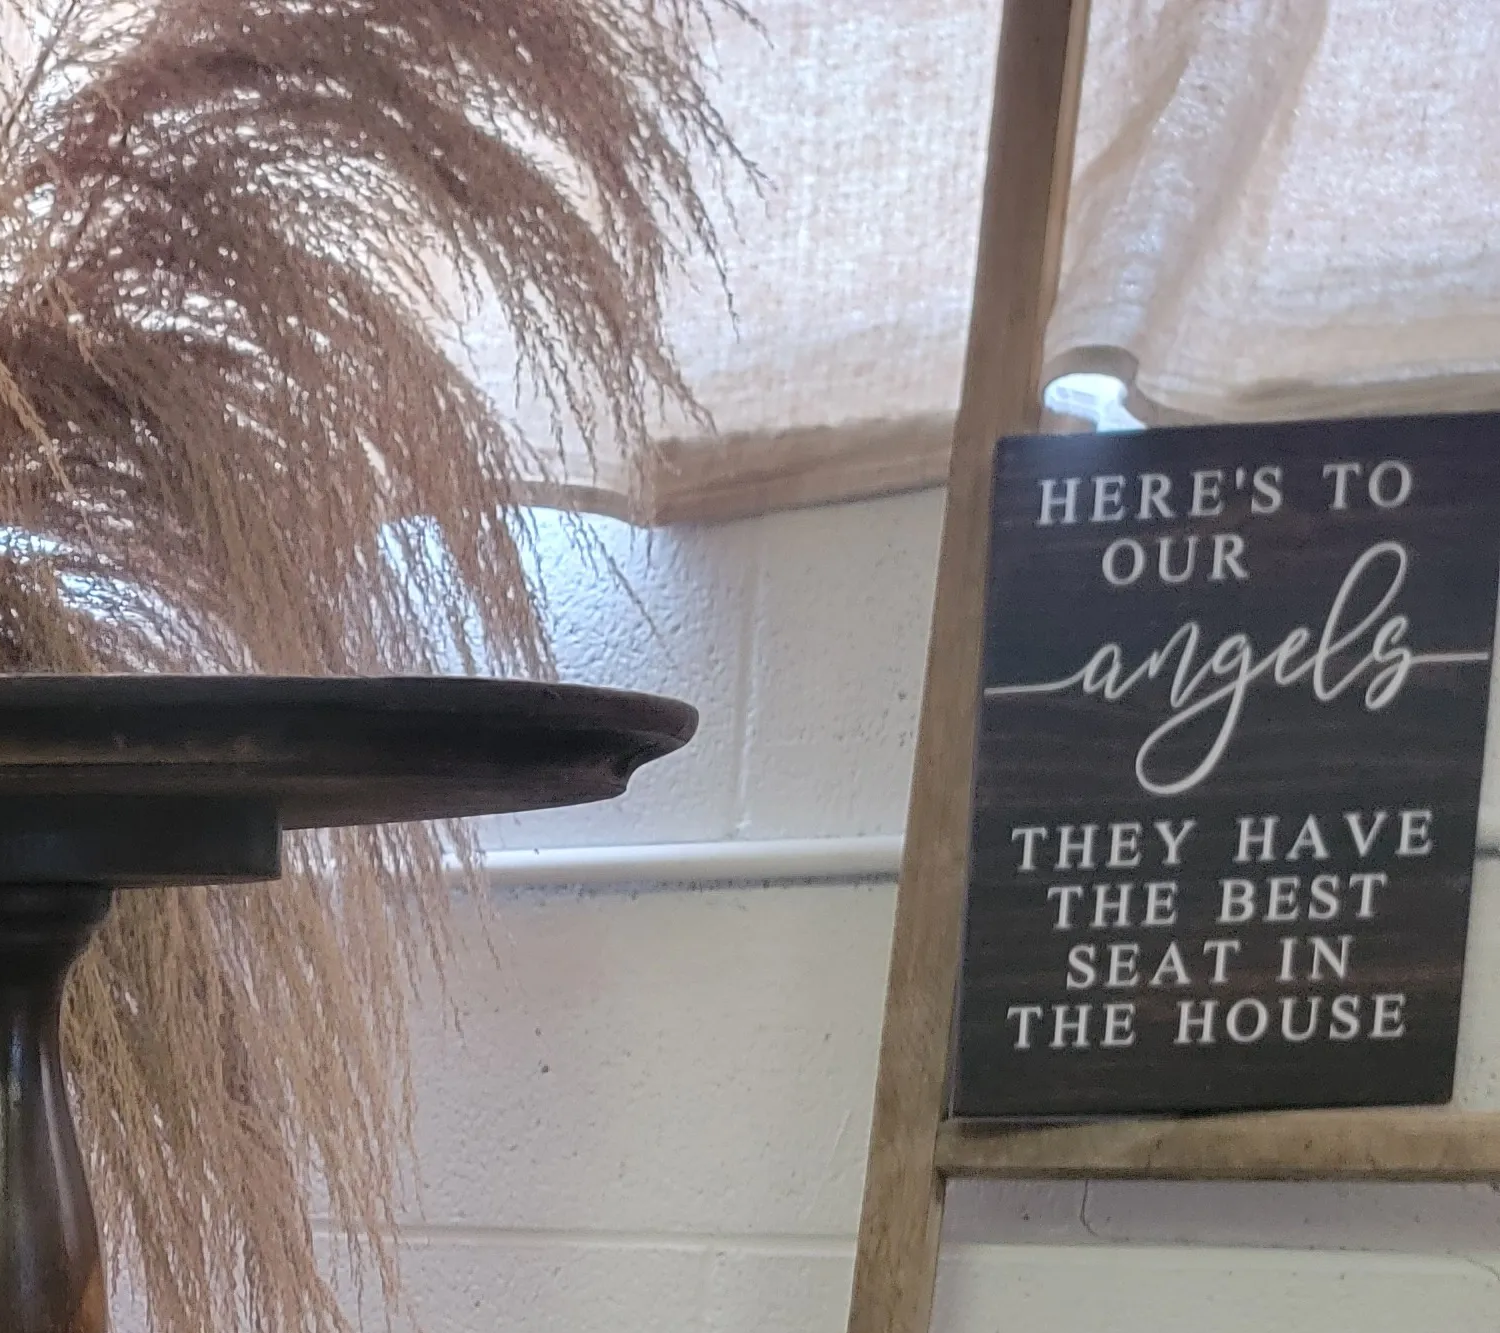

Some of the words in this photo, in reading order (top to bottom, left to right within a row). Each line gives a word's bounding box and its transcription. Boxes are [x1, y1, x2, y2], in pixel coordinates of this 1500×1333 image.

[1037, 467, 1282, 526] HERE'S
[1322, 460, 1412, 510] TO
[1101, 533, 1248, 586] OUR
[984, 541, 1489, 795] angels
[1011, 819, 1195, 871] THEY
[1235, 809, 1433, 862] HAVE
[1047, 881, 1178, 929] THE
[1218, 873, 1387, 923] BEST
[1066, 939, 1240, 989] SEAT
[1279, 935, 1352, 982] IN
[1006, 1003, 1135, 1049] THE
[1176, 993, 1406, 1044] HOUSE
